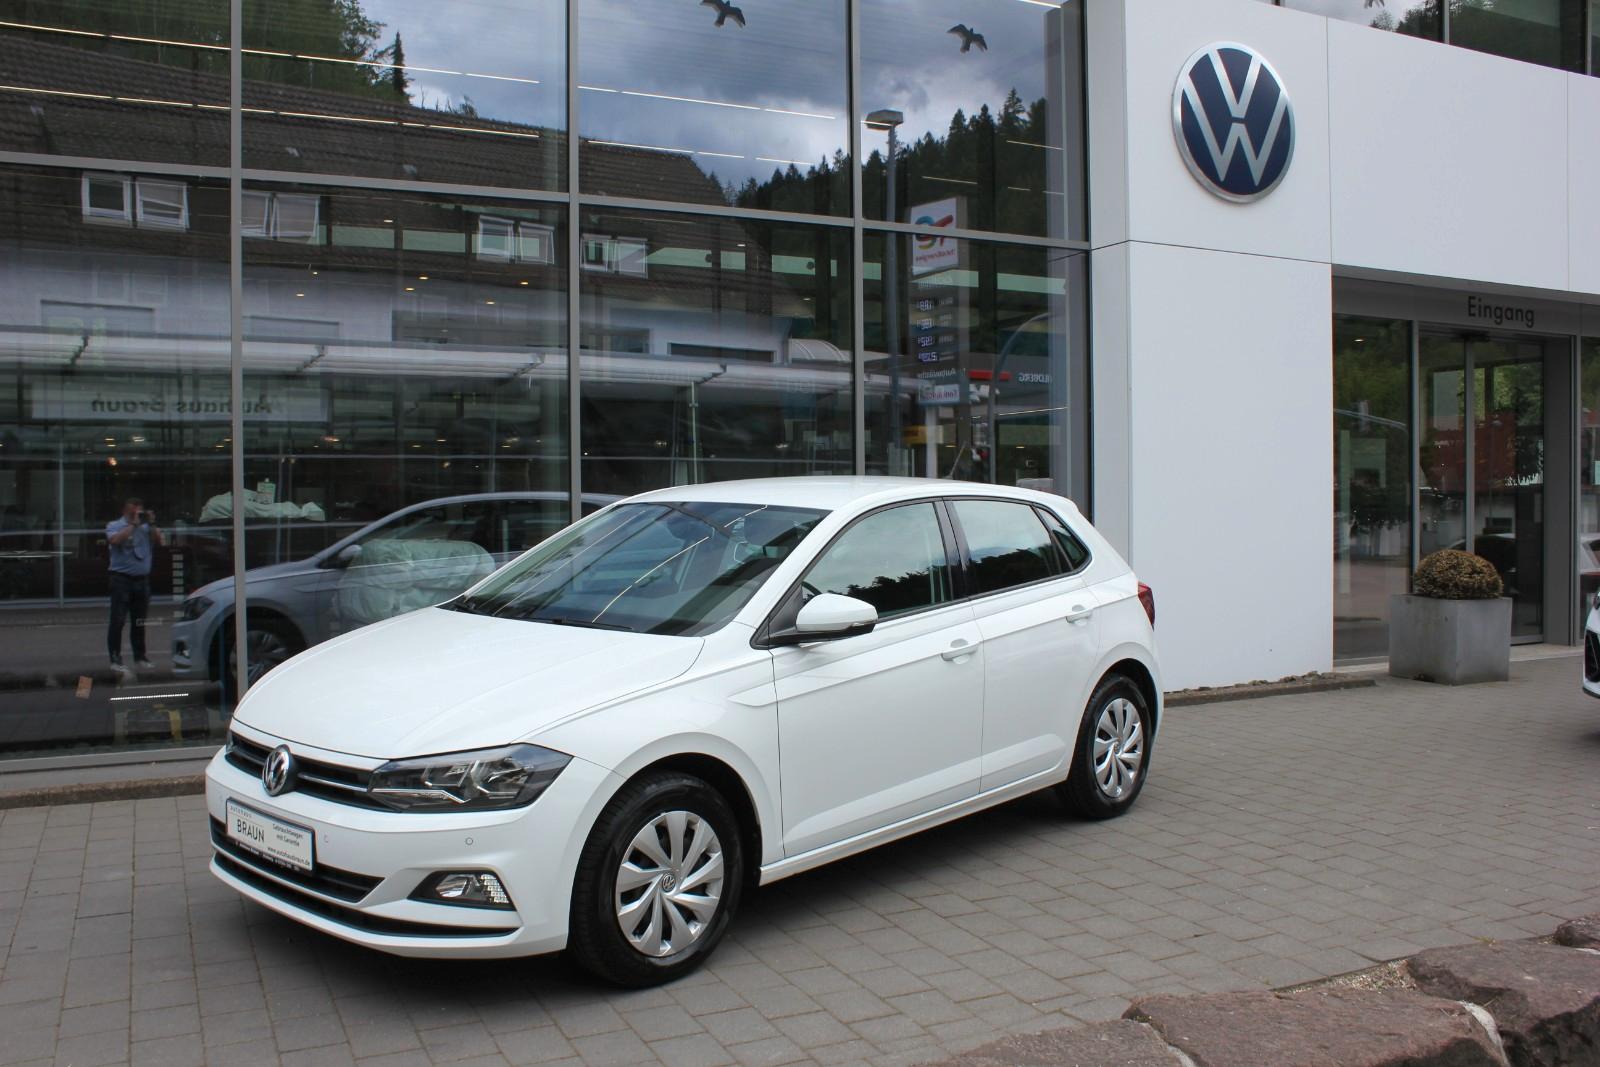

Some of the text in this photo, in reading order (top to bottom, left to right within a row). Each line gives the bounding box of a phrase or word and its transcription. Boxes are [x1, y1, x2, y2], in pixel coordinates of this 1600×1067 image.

[1175, 44, 1294, 196] VW
[1467, 295, 1535, 328] Eingang
[237, 819, 265, 843] BRAUN
